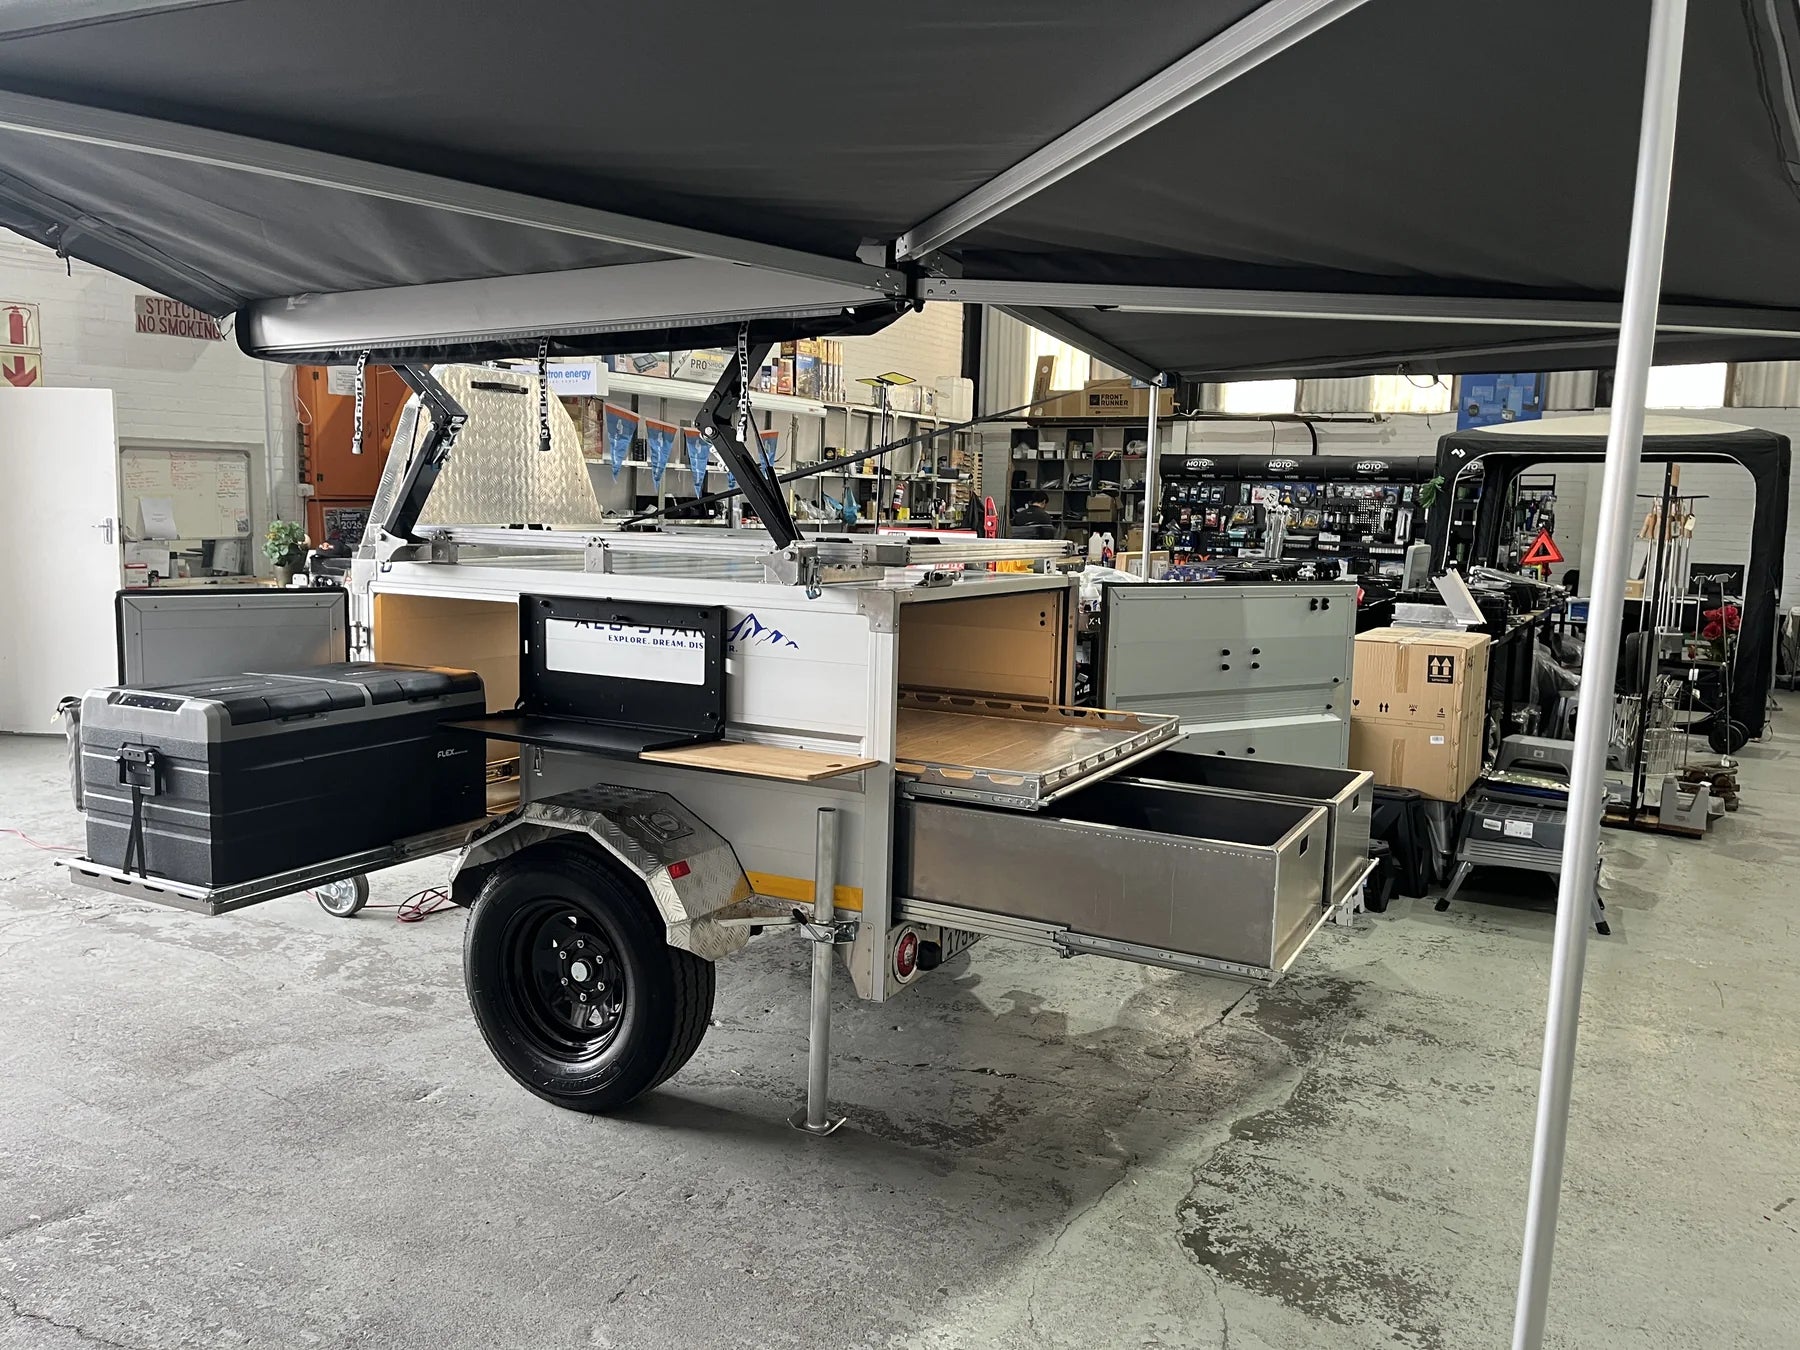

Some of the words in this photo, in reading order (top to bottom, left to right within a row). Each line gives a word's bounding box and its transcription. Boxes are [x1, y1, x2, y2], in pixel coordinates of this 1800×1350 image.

[145, 298, 211, 321] STRICTL
[137, 314, 156, 332] NO
[159, 317, 221, 339] SMOKING
[690, 358, 707, 370] PRO
[546, 370, 562, 379] tron
[564, 370, 591, 380] energy
[608, 634, 651, 646] EXPLORE.
[652, 637, 687, 649] DREAM.
[437, 748, 455, 759] FLEX
